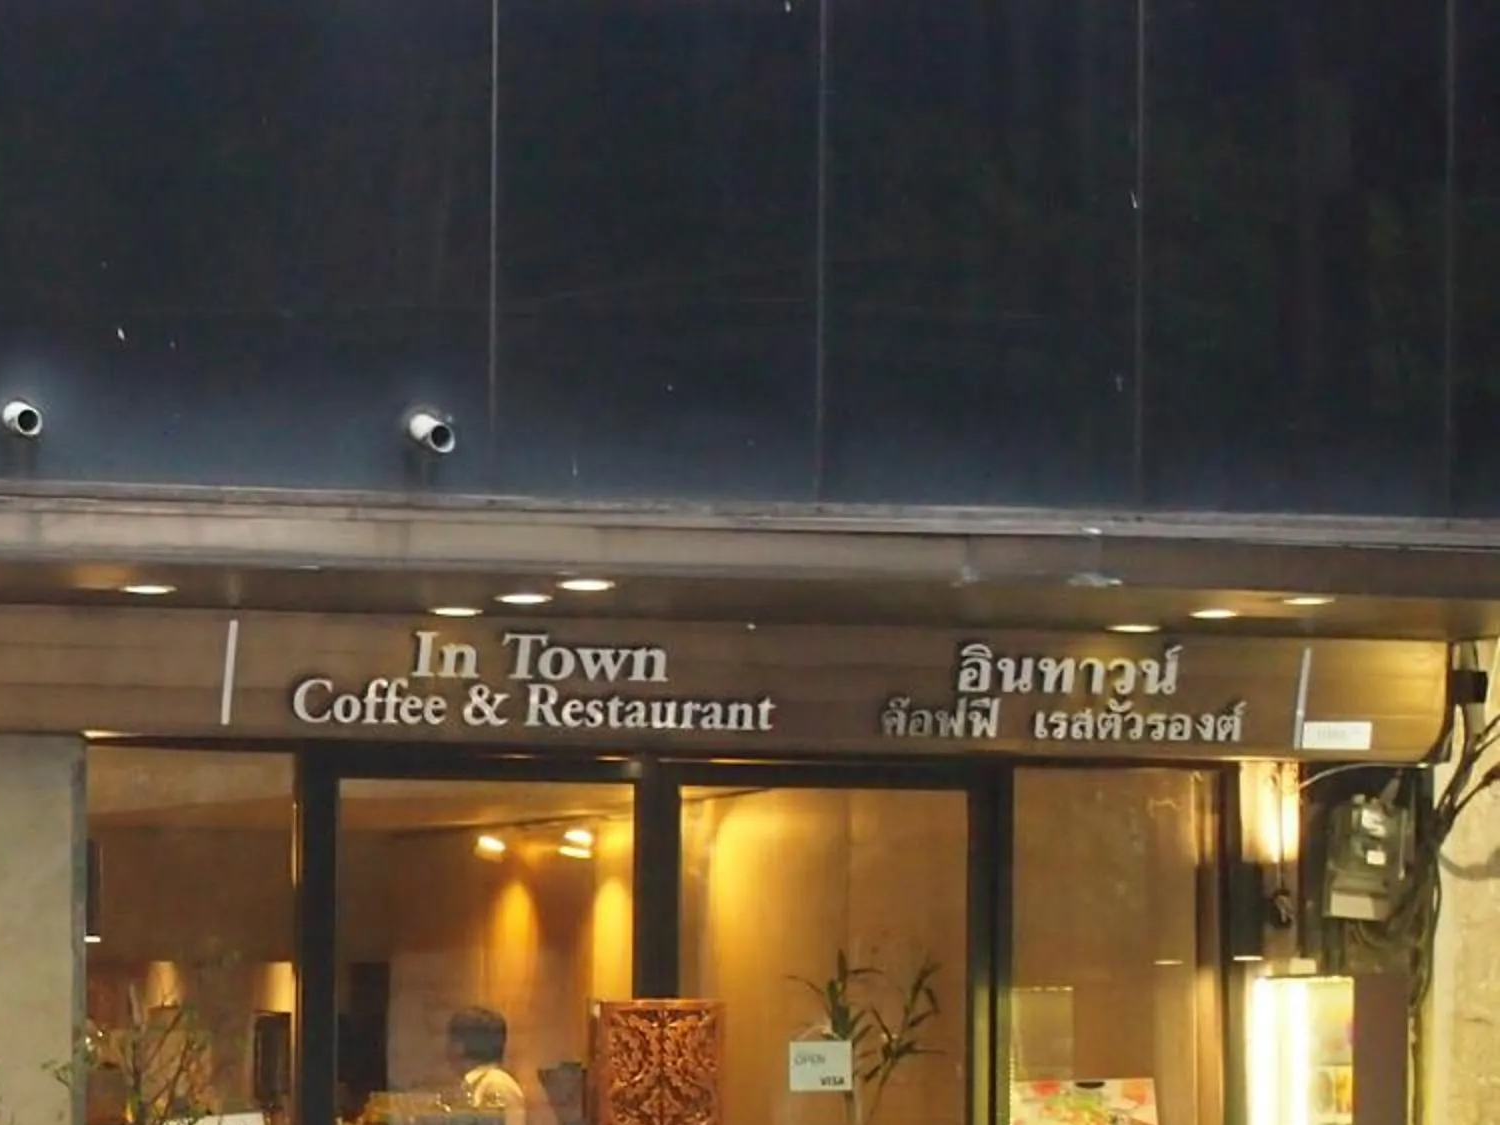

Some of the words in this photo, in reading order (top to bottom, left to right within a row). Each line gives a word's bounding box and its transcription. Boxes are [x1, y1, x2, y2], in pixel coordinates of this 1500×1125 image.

[411, 630, 481, 679] In
[503, 632, 670, 683] Town
[957, 642, 1183, 696] อินทาวน์
[293, 678, 448, 727] Coffee
[462, 682, 509, 727] &
[525, 682, 777, 731] Restaurant
